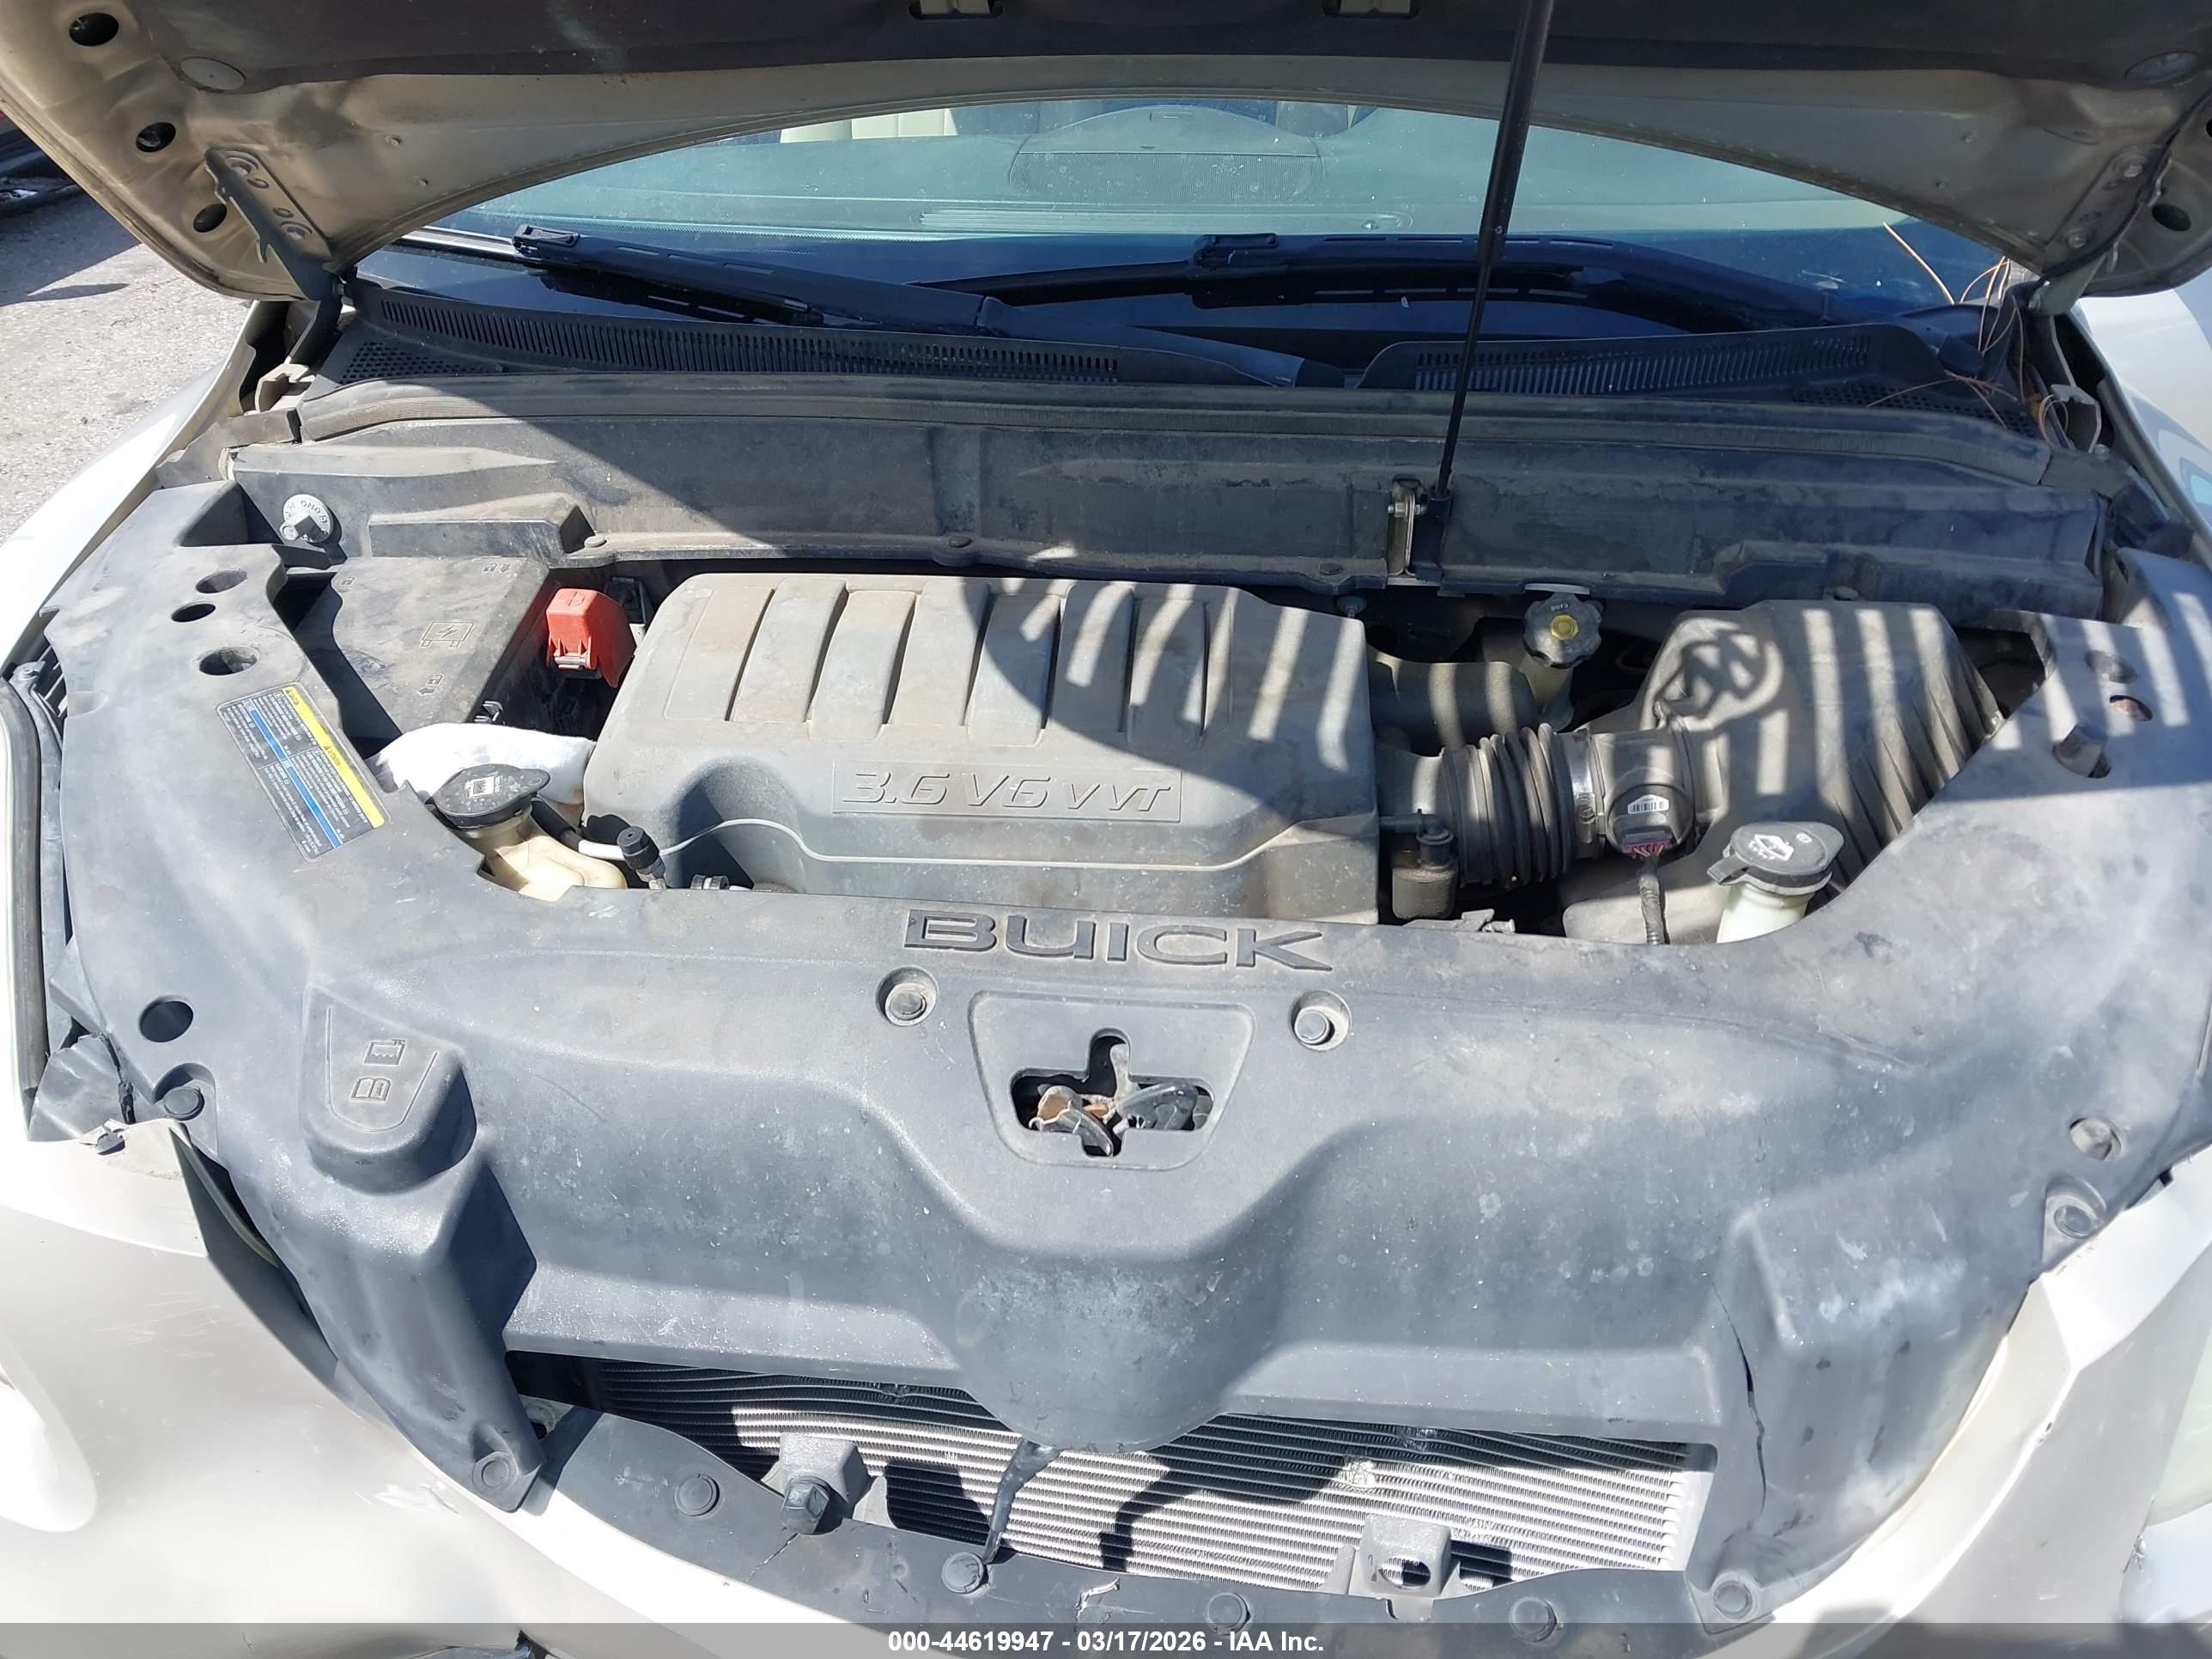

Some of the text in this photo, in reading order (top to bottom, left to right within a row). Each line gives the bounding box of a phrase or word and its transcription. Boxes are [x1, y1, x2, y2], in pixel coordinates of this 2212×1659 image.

[842, 771, 1171, 812] 3.6 V6 VVT
[903, 908, 1333, 972] BUICK
